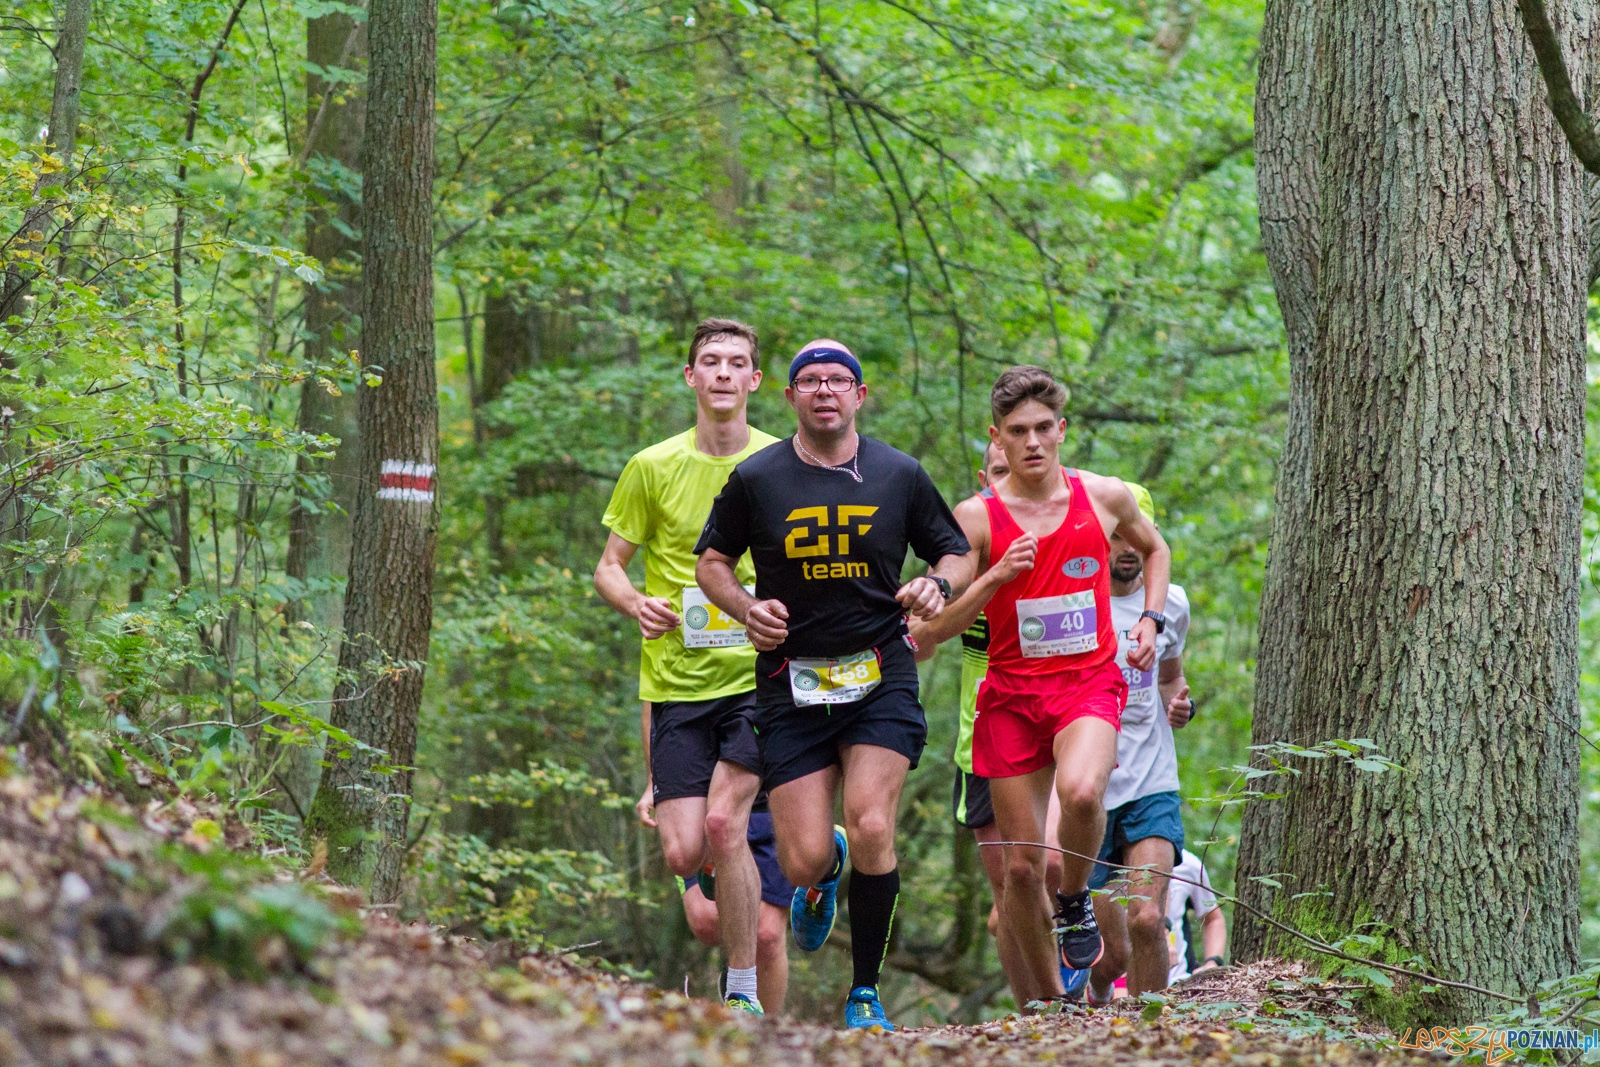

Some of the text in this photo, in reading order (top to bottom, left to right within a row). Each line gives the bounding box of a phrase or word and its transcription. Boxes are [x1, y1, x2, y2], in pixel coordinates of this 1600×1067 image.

[802, 561, 869, 581] team
[1060, 611, 1085, 632] 40
[830, 664, 869, 682] 358
